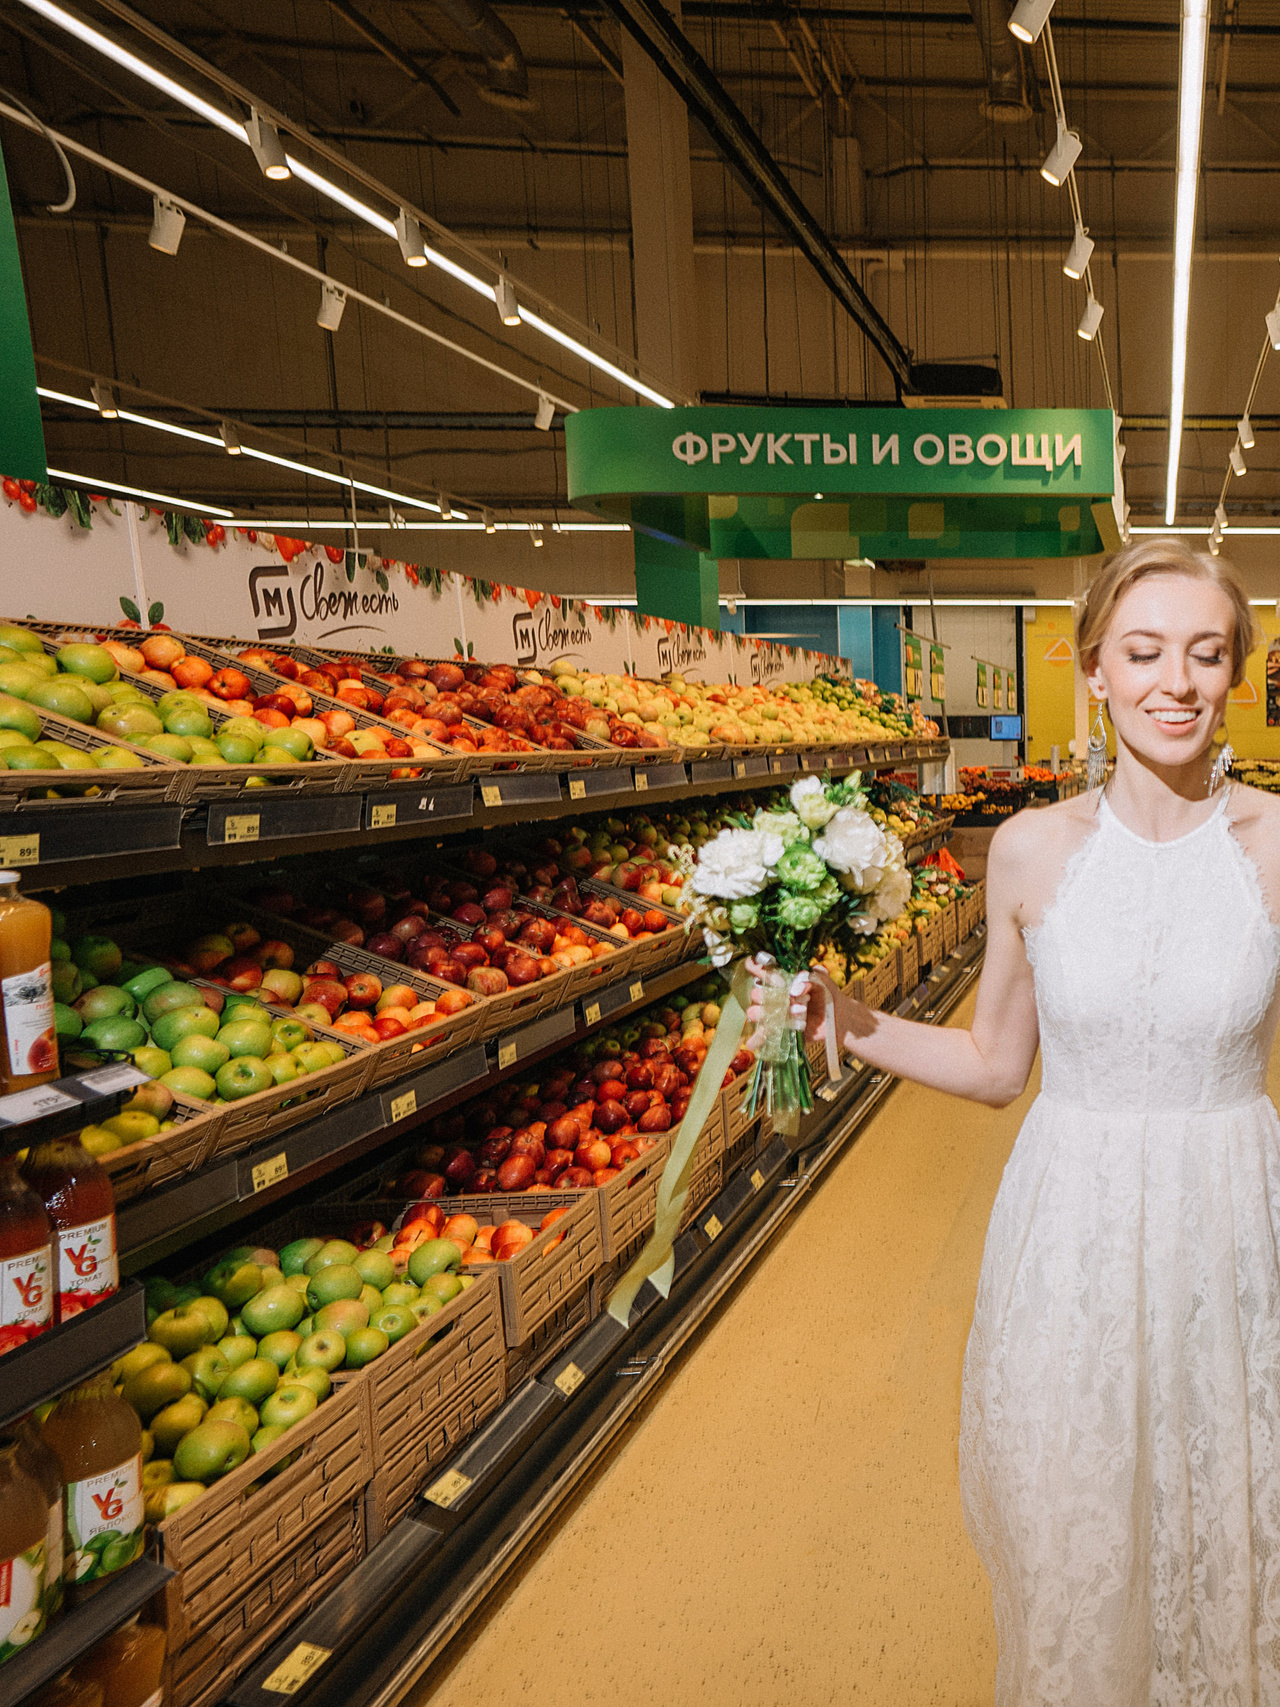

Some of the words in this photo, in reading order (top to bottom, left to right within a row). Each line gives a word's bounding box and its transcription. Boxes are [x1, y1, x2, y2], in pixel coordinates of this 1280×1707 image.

[670, 431, 858, 467] ФРУКТЫ
[872, 433, 900, 466] И
[913, 432, 1084, 472] ОВОЩИ
[299, 561, 399, 621] Свежесть
[538, 608, 592, 652] Свежесть
[246, 825, 256, 835] 89
[19, 847, 32, 858] 89
[273, 1165, 284, 1176] 89
[59, 1221, 109, 1242] PREMIUM
[86, 1461, 136, 1489] PREMIUM
[88, 1510, 135, 1537] ЯБЛОКО
